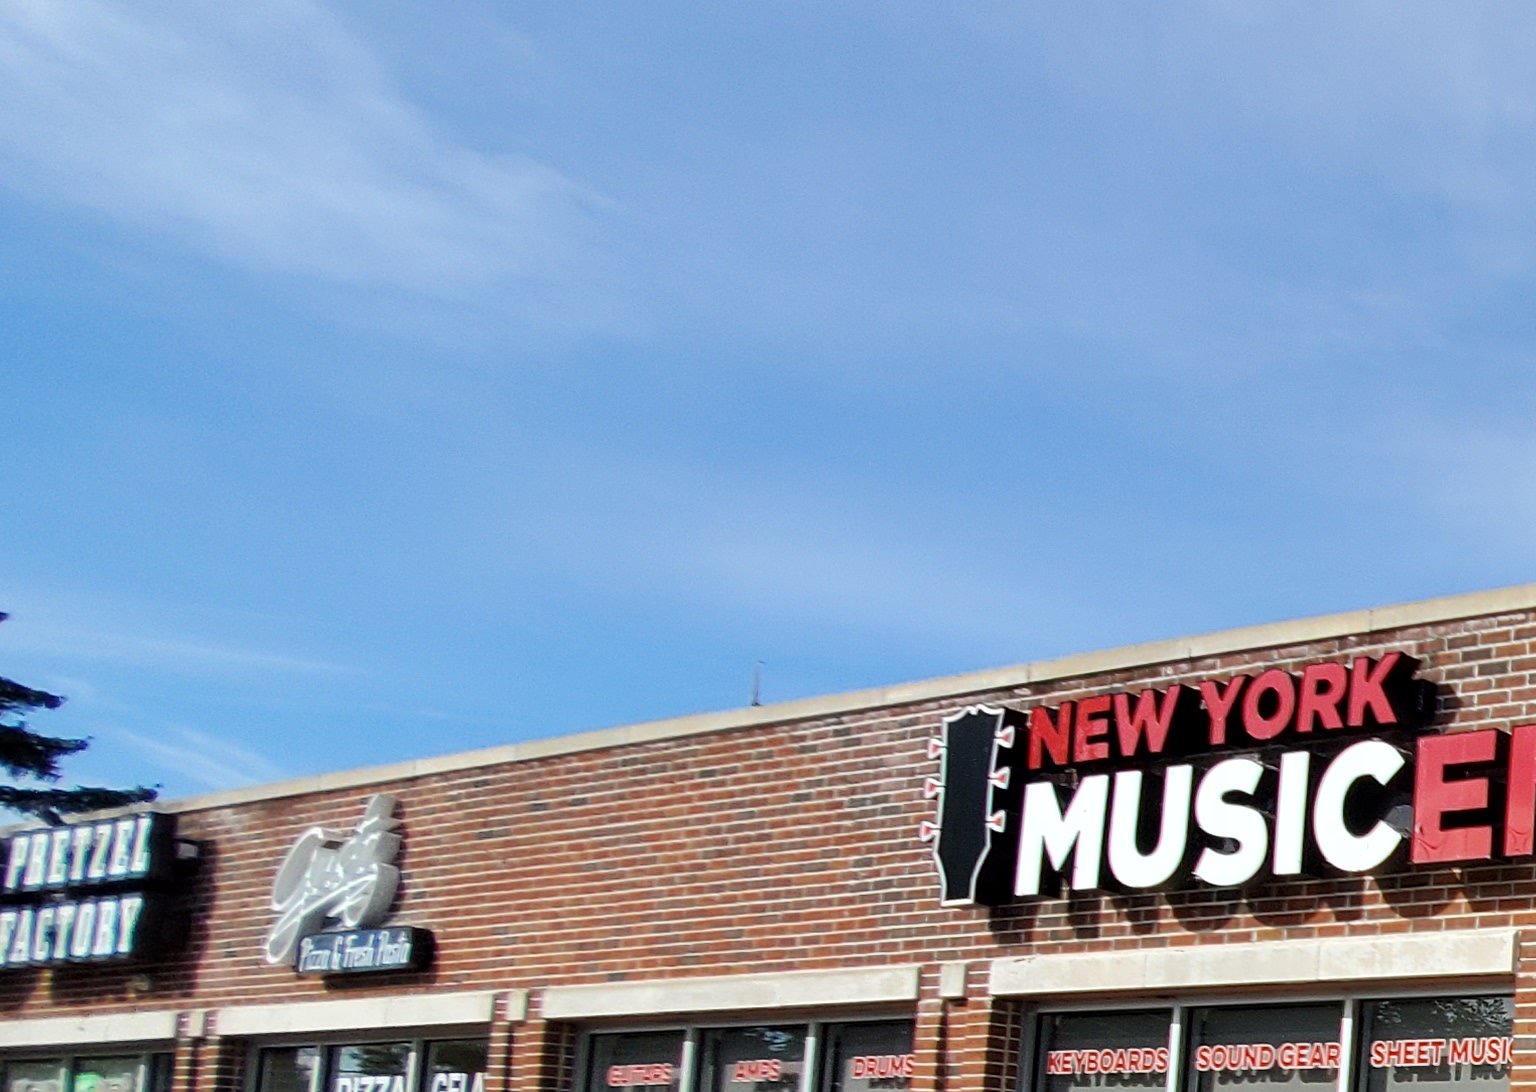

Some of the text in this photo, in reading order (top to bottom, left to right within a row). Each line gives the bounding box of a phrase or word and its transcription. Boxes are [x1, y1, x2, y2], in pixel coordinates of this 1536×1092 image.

[1028, 652, 1400, 770] NEW YORK
[4, 815, 152, 890] PRETZEL
[0, 897, 143, 966] FACTORY
[851, 1054, 915, 1080] DRUMS
[1046, 1048, 1169, 1076] KEYBOARDS
[1196, 1042, 1342, 1072] SOUND GEAR
[1369, 1038, 1447, 1070] SHEET
[731, 1059, 781, 1083] AMPS
